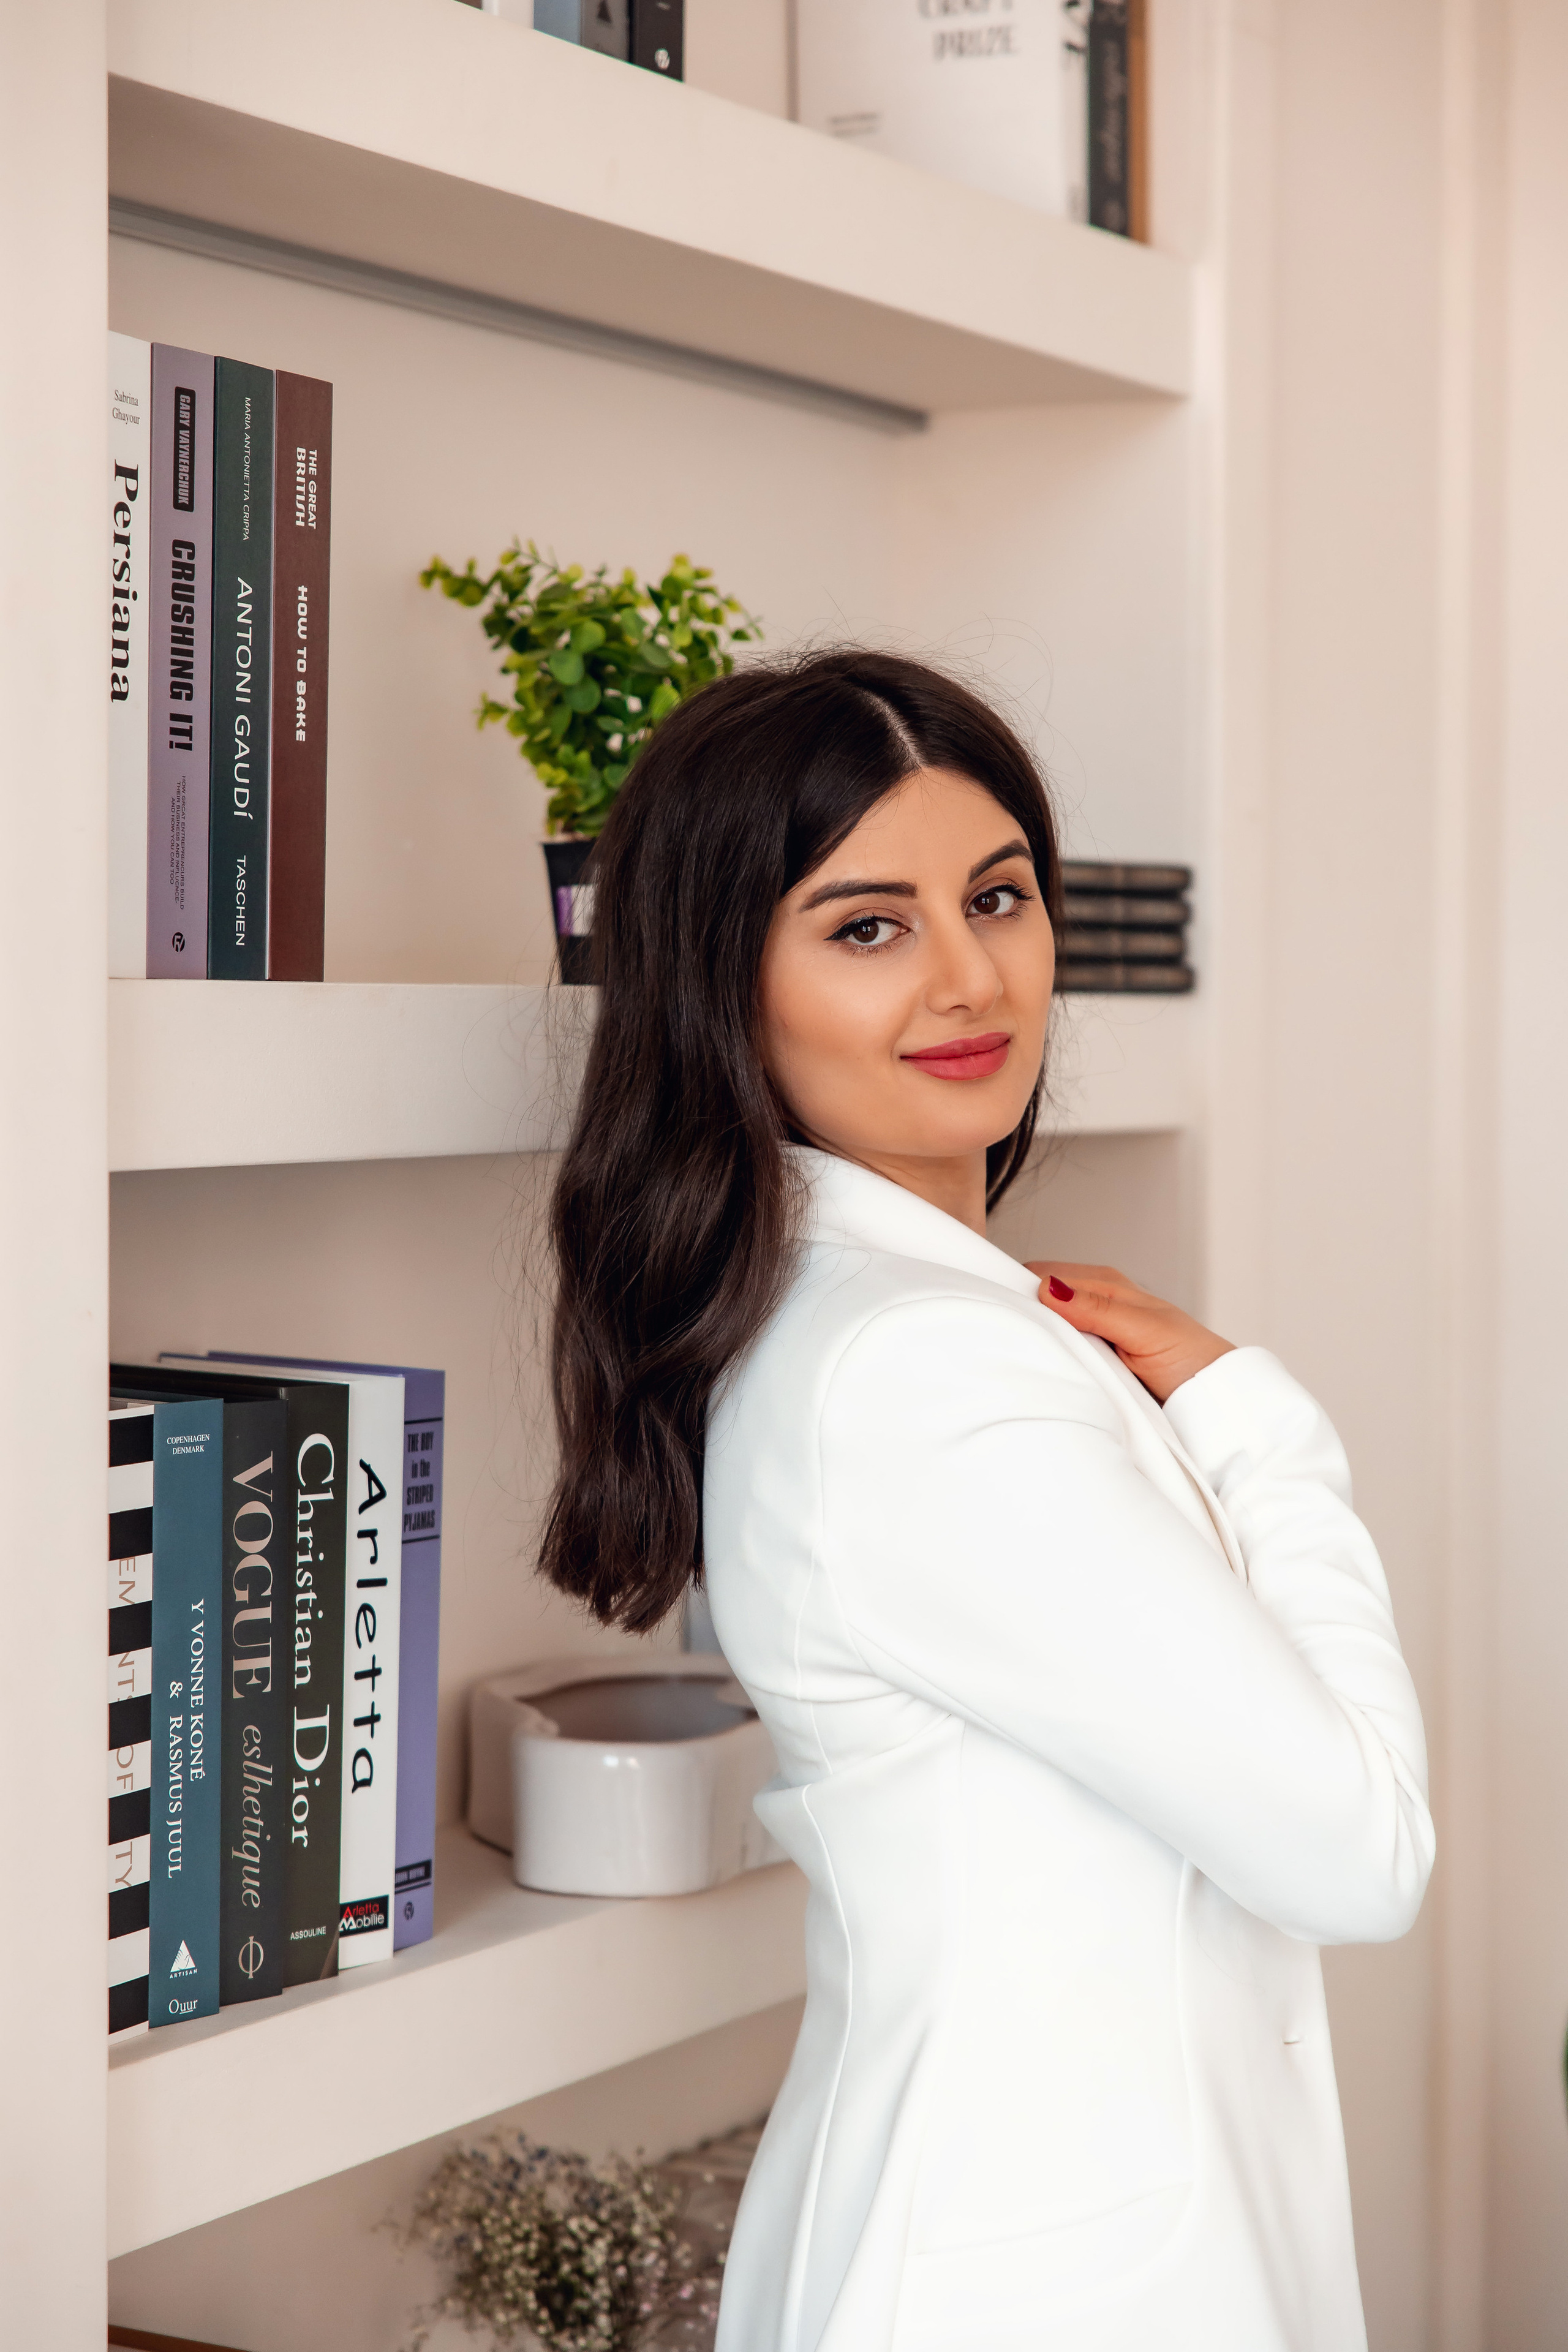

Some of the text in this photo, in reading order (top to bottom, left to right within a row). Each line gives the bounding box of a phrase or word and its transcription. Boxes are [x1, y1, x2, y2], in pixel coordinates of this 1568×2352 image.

[112, 407, 140, 424] Ghayour
[114, 389, 138, 406] Sabrina
[178, 394, 190, 505] GARY VAYNERCHUK
[296, 447, 306, 527] BRITISH
[308, 450, 317, 529] THE GREAT
[110, 458, 139, 703] Persiana
[168, 539, 195, 752] CRUSHING IT!
[296, 585, 307, 742] HOW TO BAKE
[233, 576, 253, 820] ANTONI GAUDÍ
[236, 855, 246, 946] TASCHEN
[167, 1433, 210, 1445] COPENHAGEN
[172, 1445, 205, 1455] DENMARK
[407, 1433, 419, 1453] THE
[404, 1510, 435, 1532] PYJAMAS
[407, 1484, 434, 1506] STRIPED
[232, 1450, 273, 1699] VOGUE
[292, 1433, 334, 1848] Christian Dior
[351, 1458, 388, 1794] Arletta
[166, 1681, 183, 1879] & RASMUS JUUL
[190, 1713, 206, 1782] KONÉ
[290, 1926, 326, 1940] ASSOULINE
[169, 1969, 198, 1979] ARTISAN
